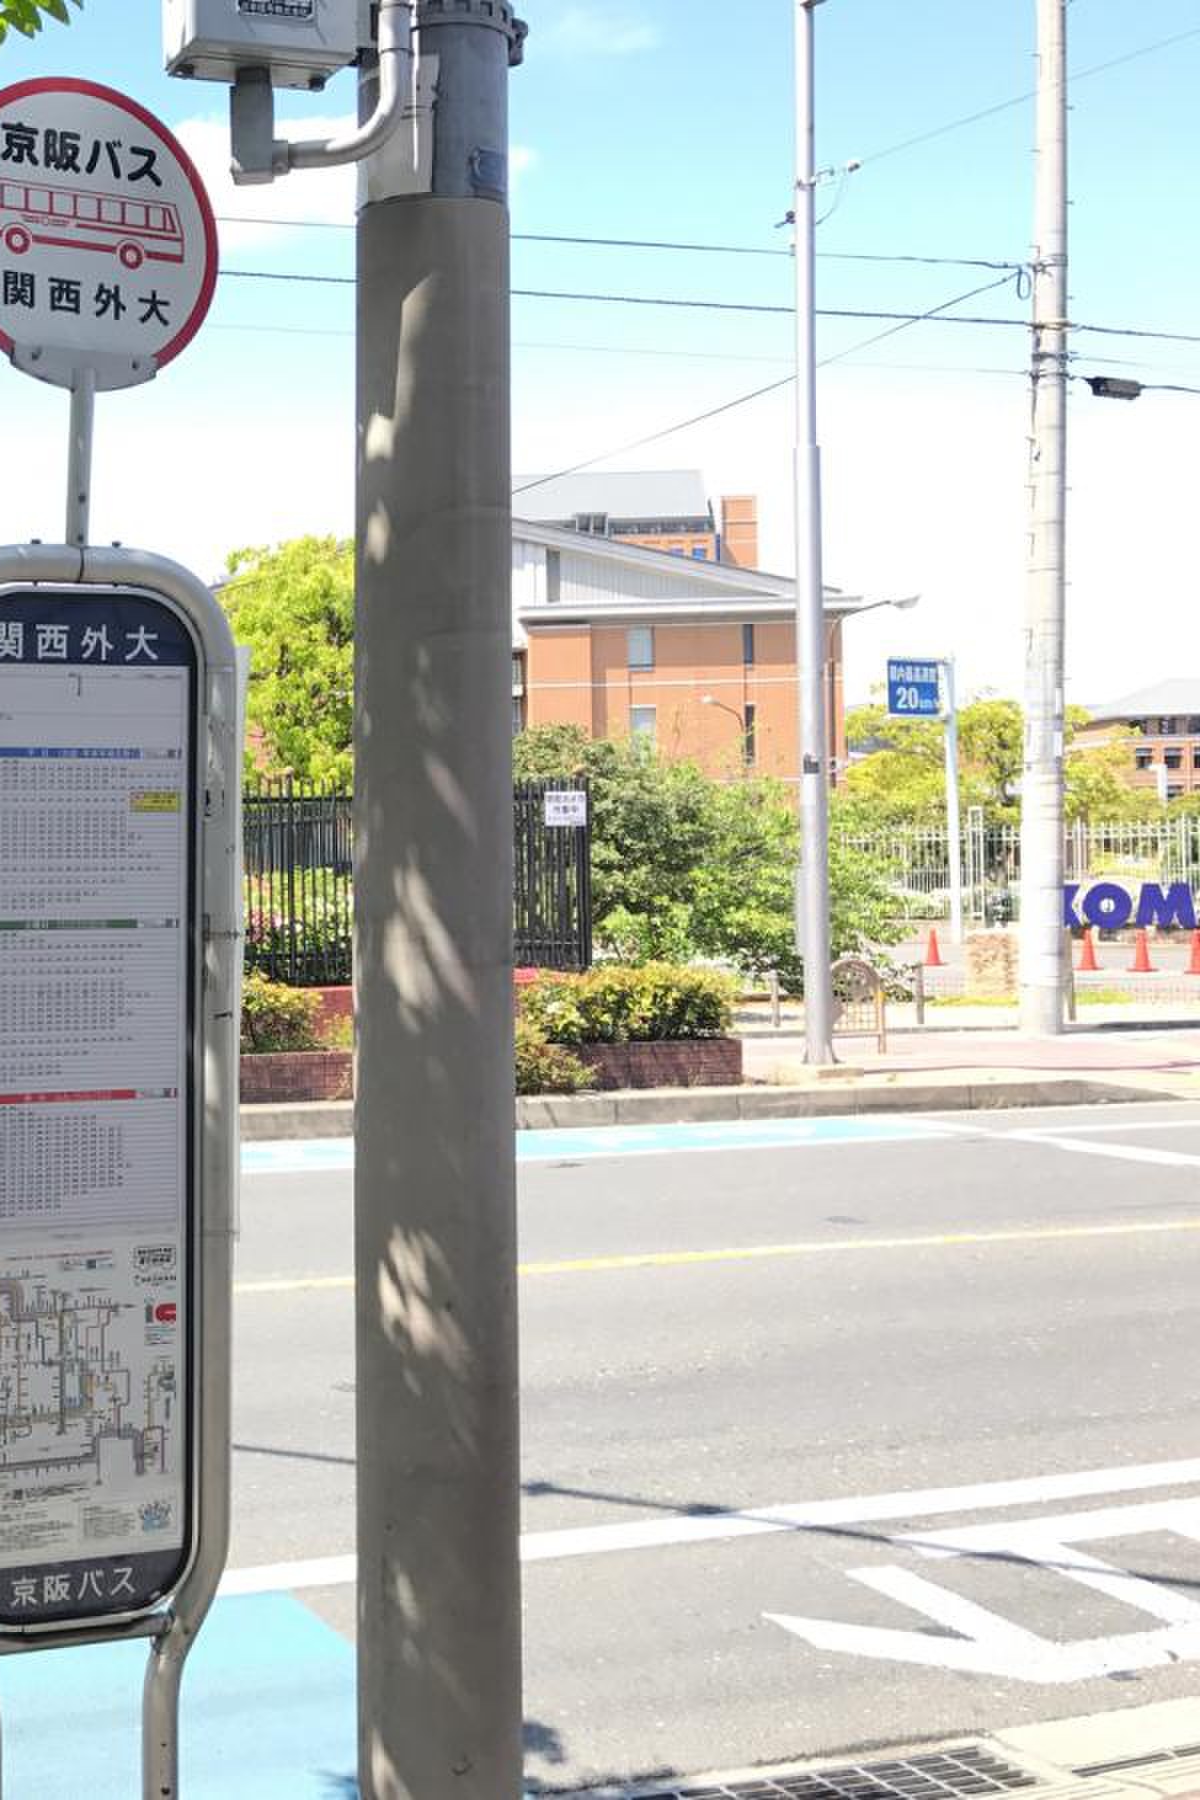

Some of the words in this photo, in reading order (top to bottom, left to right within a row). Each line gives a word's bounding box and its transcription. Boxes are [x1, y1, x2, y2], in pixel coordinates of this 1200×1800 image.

[0, 122, 163, 187] 京阪バス
[3, 270, 171, 326] 関西外大
[9, 1567, 136, 1608] 京阪バス
